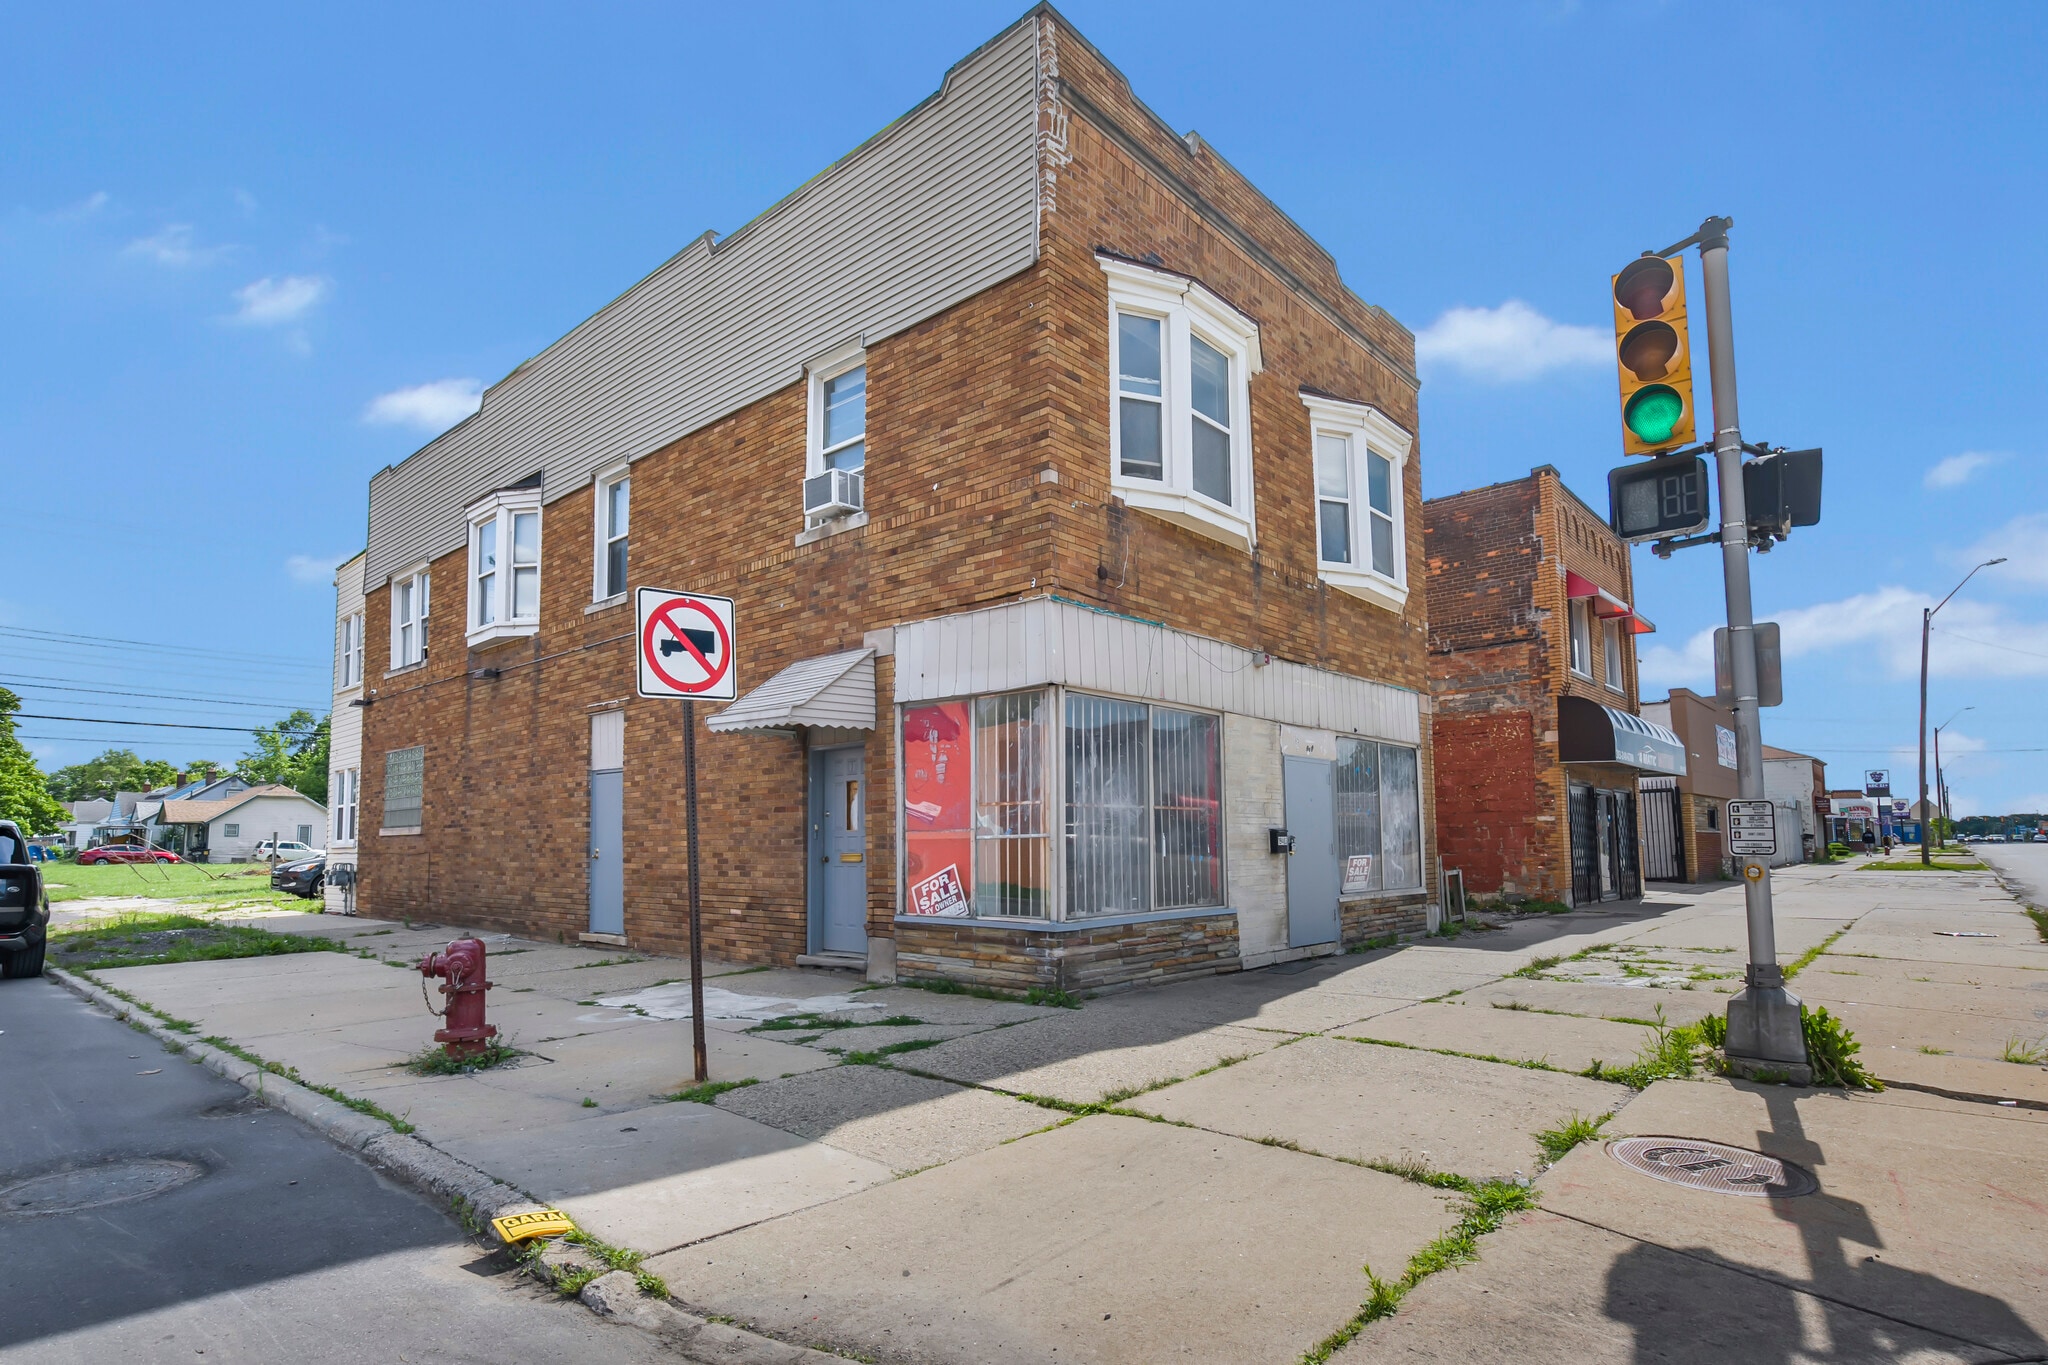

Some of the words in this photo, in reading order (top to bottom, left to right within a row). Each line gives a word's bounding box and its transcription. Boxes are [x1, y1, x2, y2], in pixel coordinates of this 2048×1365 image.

[1353, 858, 1367, 866] FOR
[1348, 867, 1368, 876] SALE
[921, 874, 950, 896] FOR
[920, 881, 958, 910] SALE
[935, 896, 958, 911] OWNER
